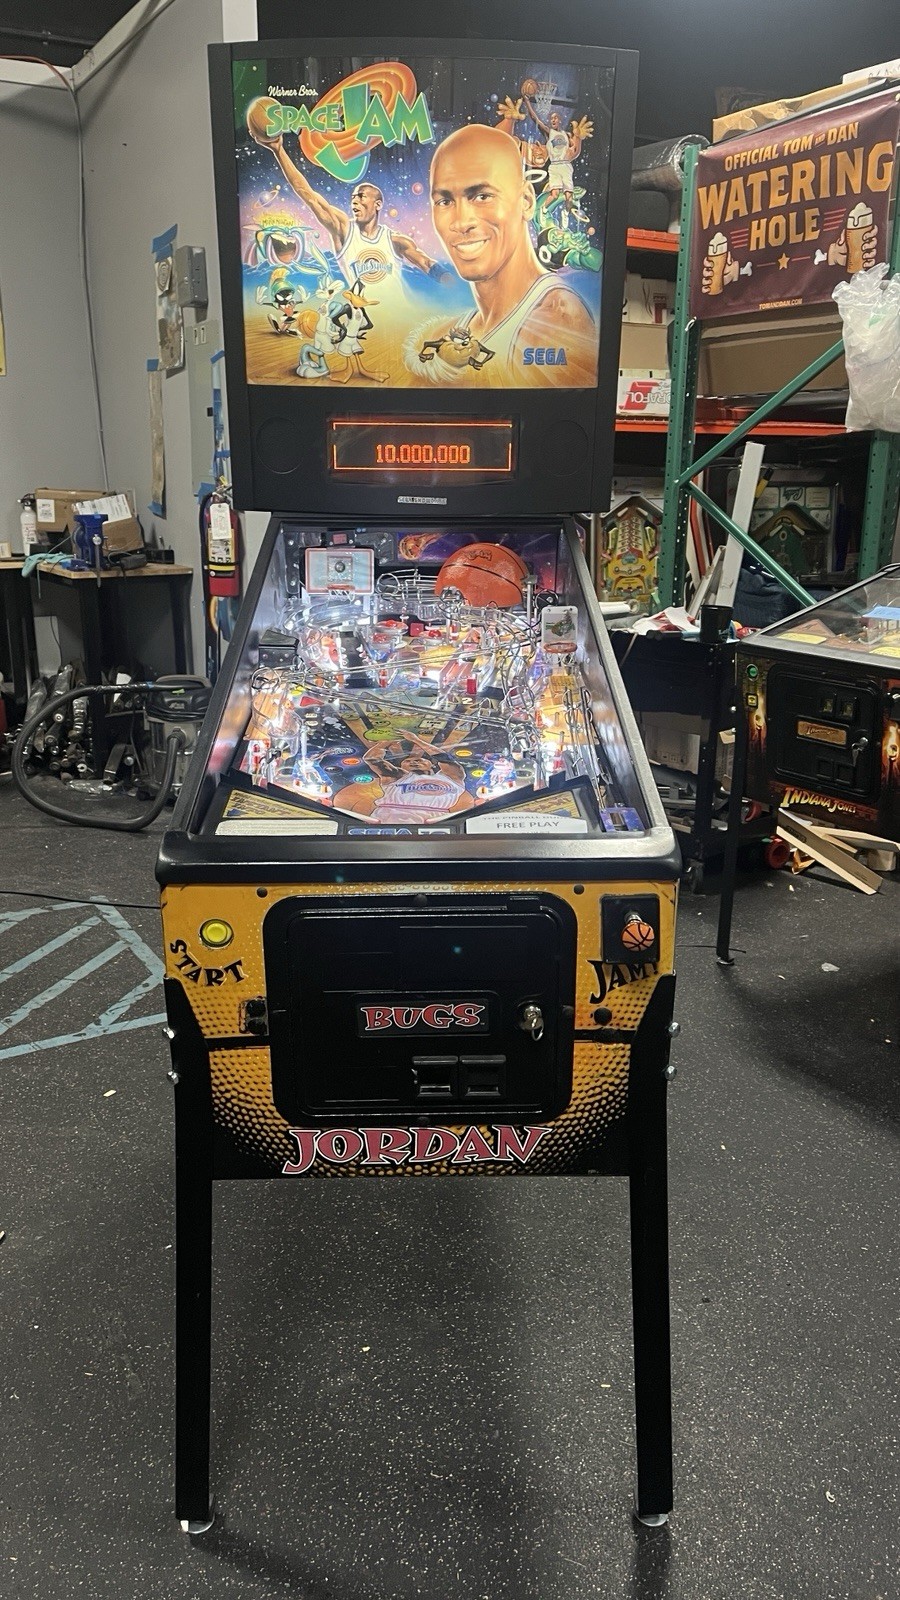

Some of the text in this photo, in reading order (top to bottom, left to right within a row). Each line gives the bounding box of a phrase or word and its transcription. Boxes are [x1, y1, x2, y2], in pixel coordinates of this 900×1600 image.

[268, 85, 319, 97] Warner Bros.
[265, 82, 436, 184] SPACE JAM
[724, 144, 780, 172] OFFICIAL
[783, 133, 815, 157] TOM
[826, 121, 860, 146] DAN
[697, 140, 895, 230] WATERING
[749, 207, 821, 251] HOLE
[523, 347, 567, 366] SEGA
[780, 787, 857, 813] INDIANA JONES
[169, 939, 246, 987] START
[360, 1003, 486, 1031] BUGS
[282, 1125, 553, 1175] JORDAN
